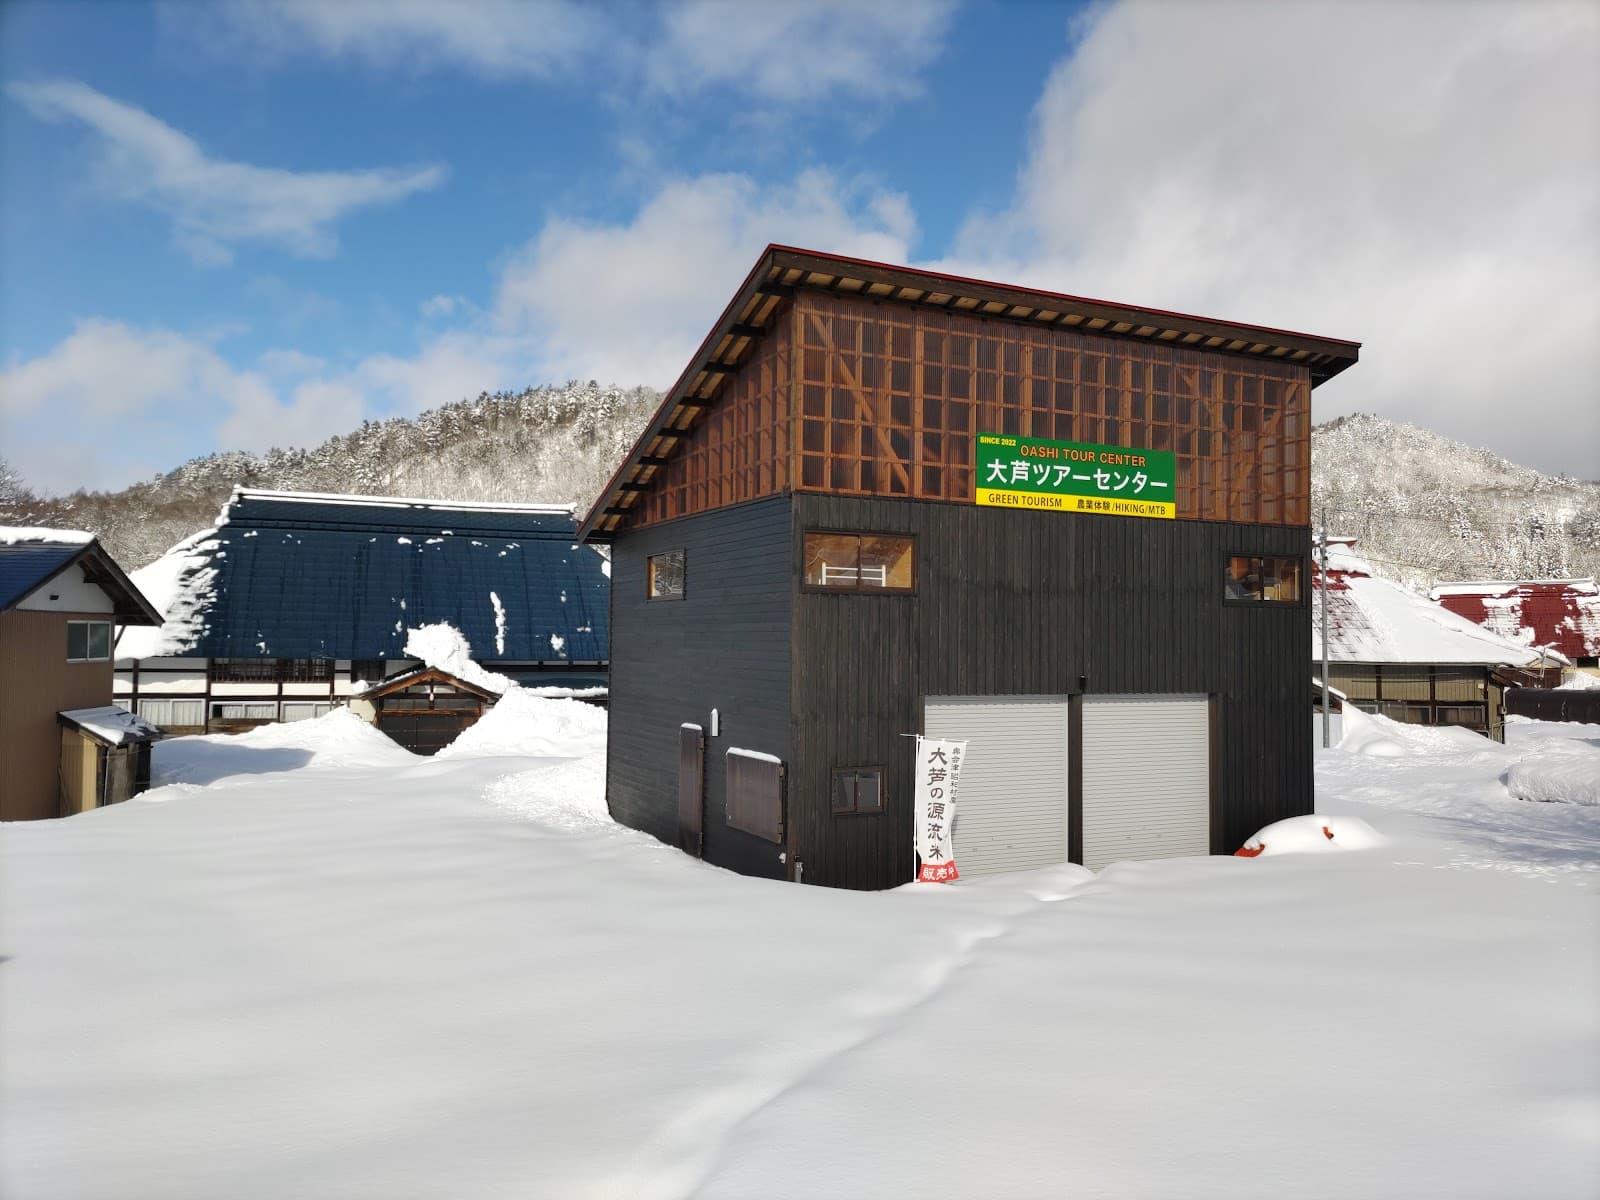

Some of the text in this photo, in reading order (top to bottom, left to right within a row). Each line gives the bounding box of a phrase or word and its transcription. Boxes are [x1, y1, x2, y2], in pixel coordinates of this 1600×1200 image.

[980, 436, 1017, 446] SINCE 2022
[1020, 445, 1146, 467] OASHI TOUR CENTER
[987, 459, 1168, 494] 大芦ツアーセンター
[988, 493, 1062, 507] GREEN TOURISM
[927, 747, 948, 860] 大芦の源流米
